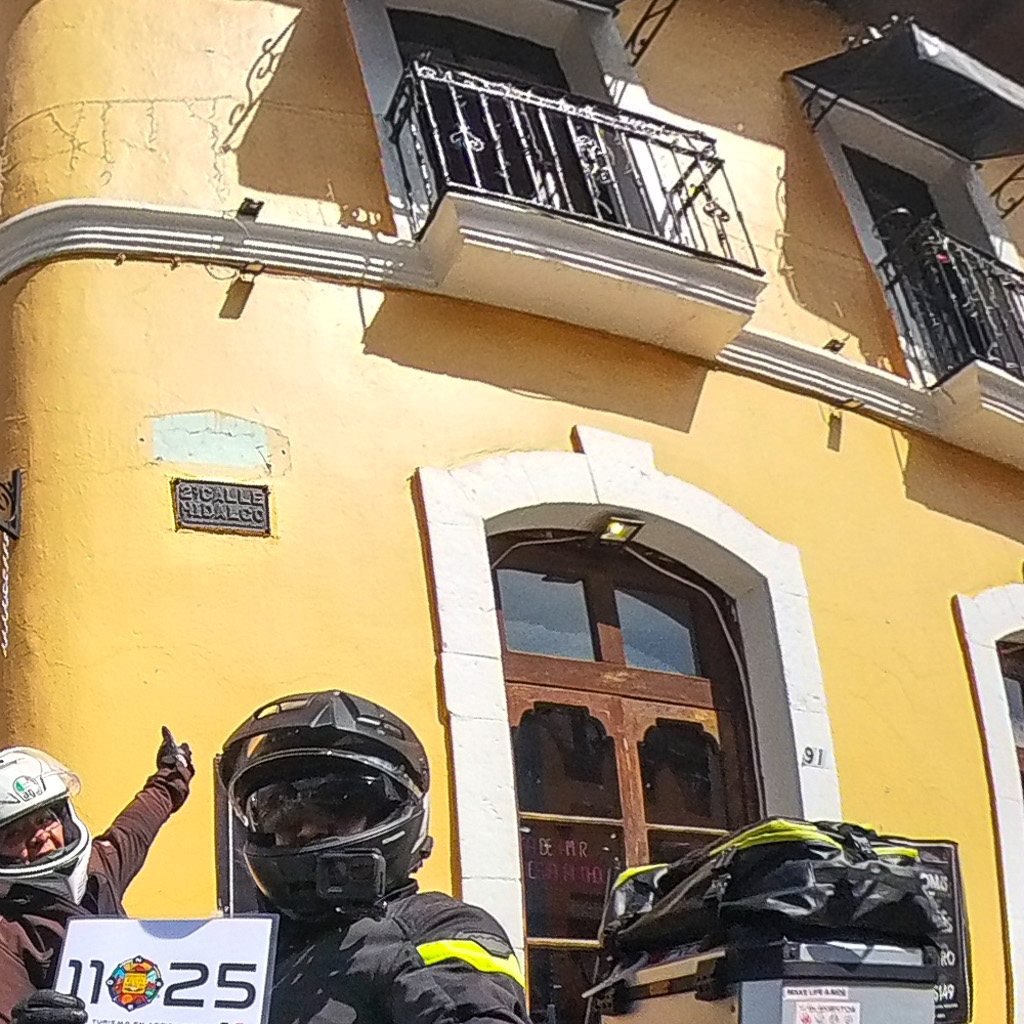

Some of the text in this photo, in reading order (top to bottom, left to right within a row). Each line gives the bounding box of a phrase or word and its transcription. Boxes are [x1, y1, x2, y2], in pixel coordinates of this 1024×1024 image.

[199, 486, 264, 506] CALLE
[179, 502, 264, 523] HIDALGO
[804, 746, 823, 766] 91
